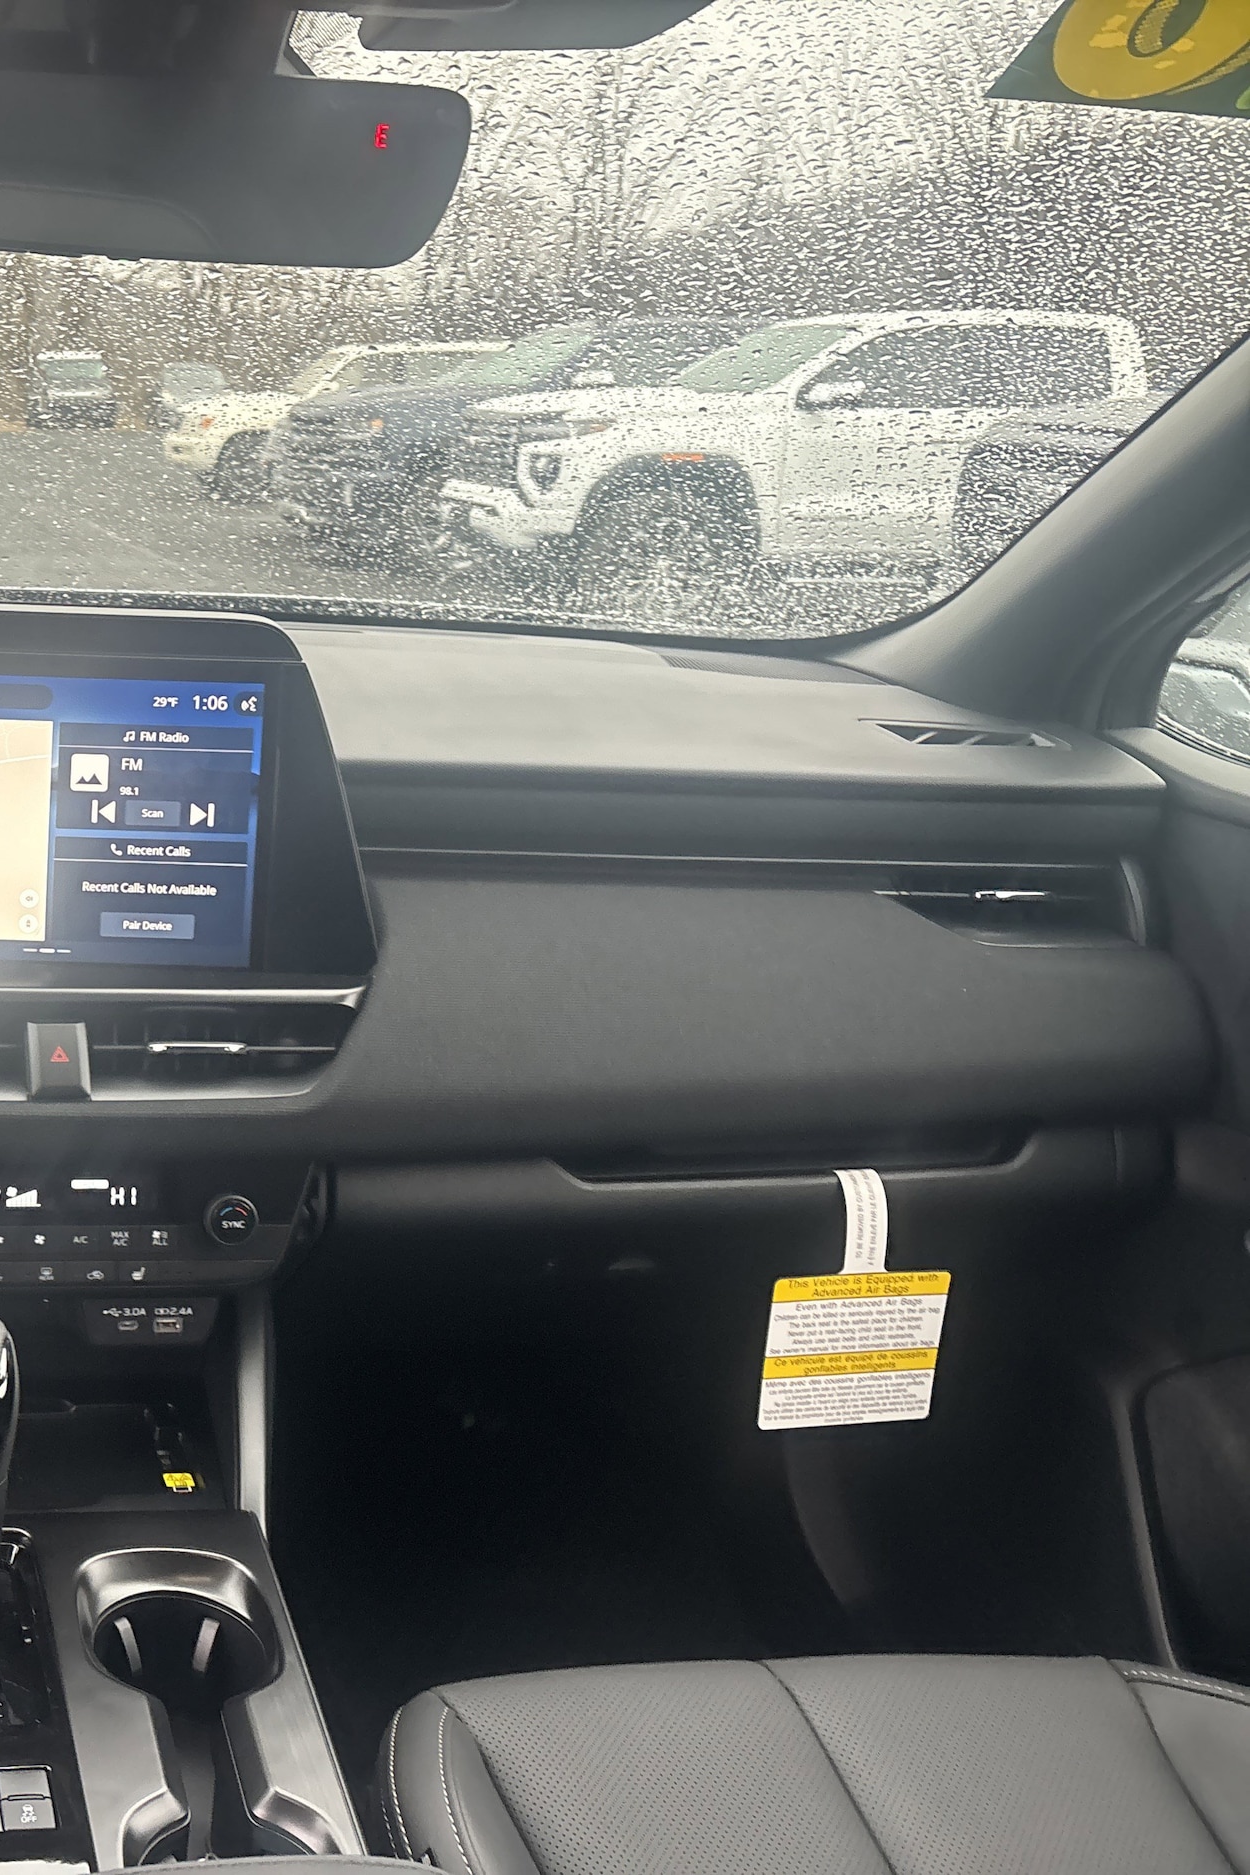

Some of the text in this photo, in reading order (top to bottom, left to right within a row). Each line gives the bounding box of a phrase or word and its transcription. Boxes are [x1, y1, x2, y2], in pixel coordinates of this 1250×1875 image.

[374, 123, 390, 148] E
[192, 695, 228, 711] 1:06
[140, 731, 190, 743] FM Radio
[121, 757, 143, 771] FM
[119, 786, 139, 796] 98.1
[141, 808, 164, 818] Scan
[127, 844, 192, 857] Recent Calls
[82, 881, 217, 896] Recent Calls Not Available
[122, 920, 173, 932] Pair Device
[221, 1220, 246, 1229] SYNC
[73, 1236, 88, 1244] A/C
[112, 1238, 128, 1247] A/C
[152, 1238, 168, 1246] ALL
[789, 1273, 939, 1288] This Vehicle is Equipped with
[812, 1284, 910, 1297] Advanced Air Bags
[796, 1303, 817, 1312] Even
[820, 1302, 837, 1310] with
[840, 1299, 882, 1309] Advanced
[900, 1298, 923, 1307] Bags
[122, 1307, 147, 1316] 3.0A
[170, 1307, 193, 1316] 2.4A
[774, 1358, 787, 1367] Ce
[890, 1351, 928, 1360] coussins
[804, 1361, 896, 1376] gonflables intelligents
[20, 1815, 37, 1823] OFF
